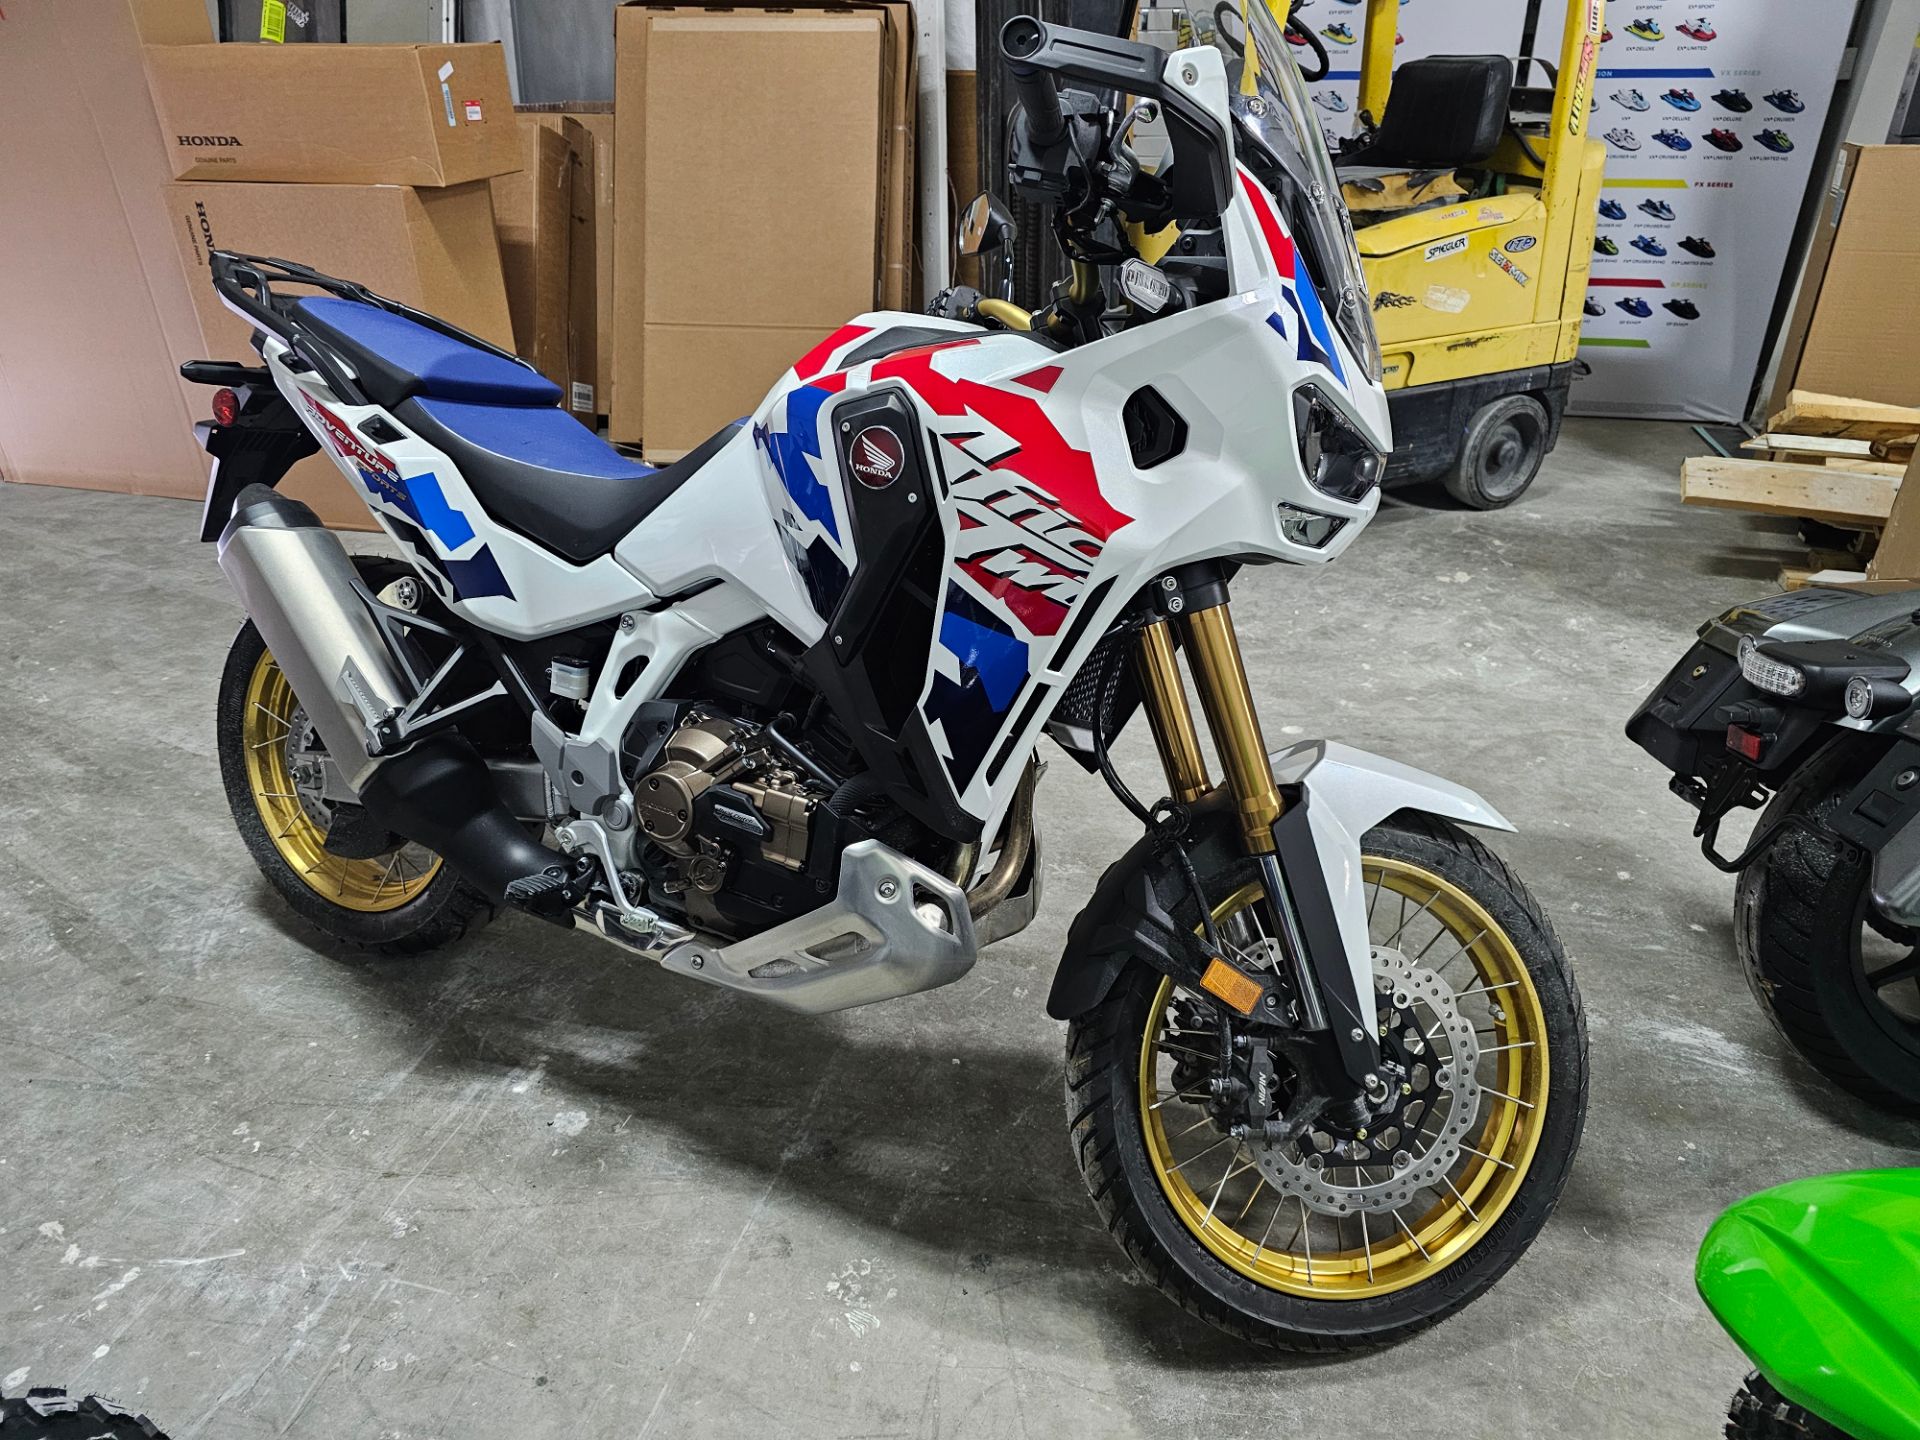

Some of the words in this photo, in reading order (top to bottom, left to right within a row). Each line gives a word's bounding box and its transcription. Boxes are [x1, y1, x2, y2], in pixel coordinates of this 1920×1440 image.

[176, 136, 243, 146] HONDA
[195, 201, 216, 253] HON
[1426, 237, 1467, 260] SPIEGLER
[1508, 238, 1533, 250] ITP
[306, 406, 399, 482] ADVENTURE
[356, 460, 407, 501] SPORTS
[856, 464, 893, 479] HONDA
